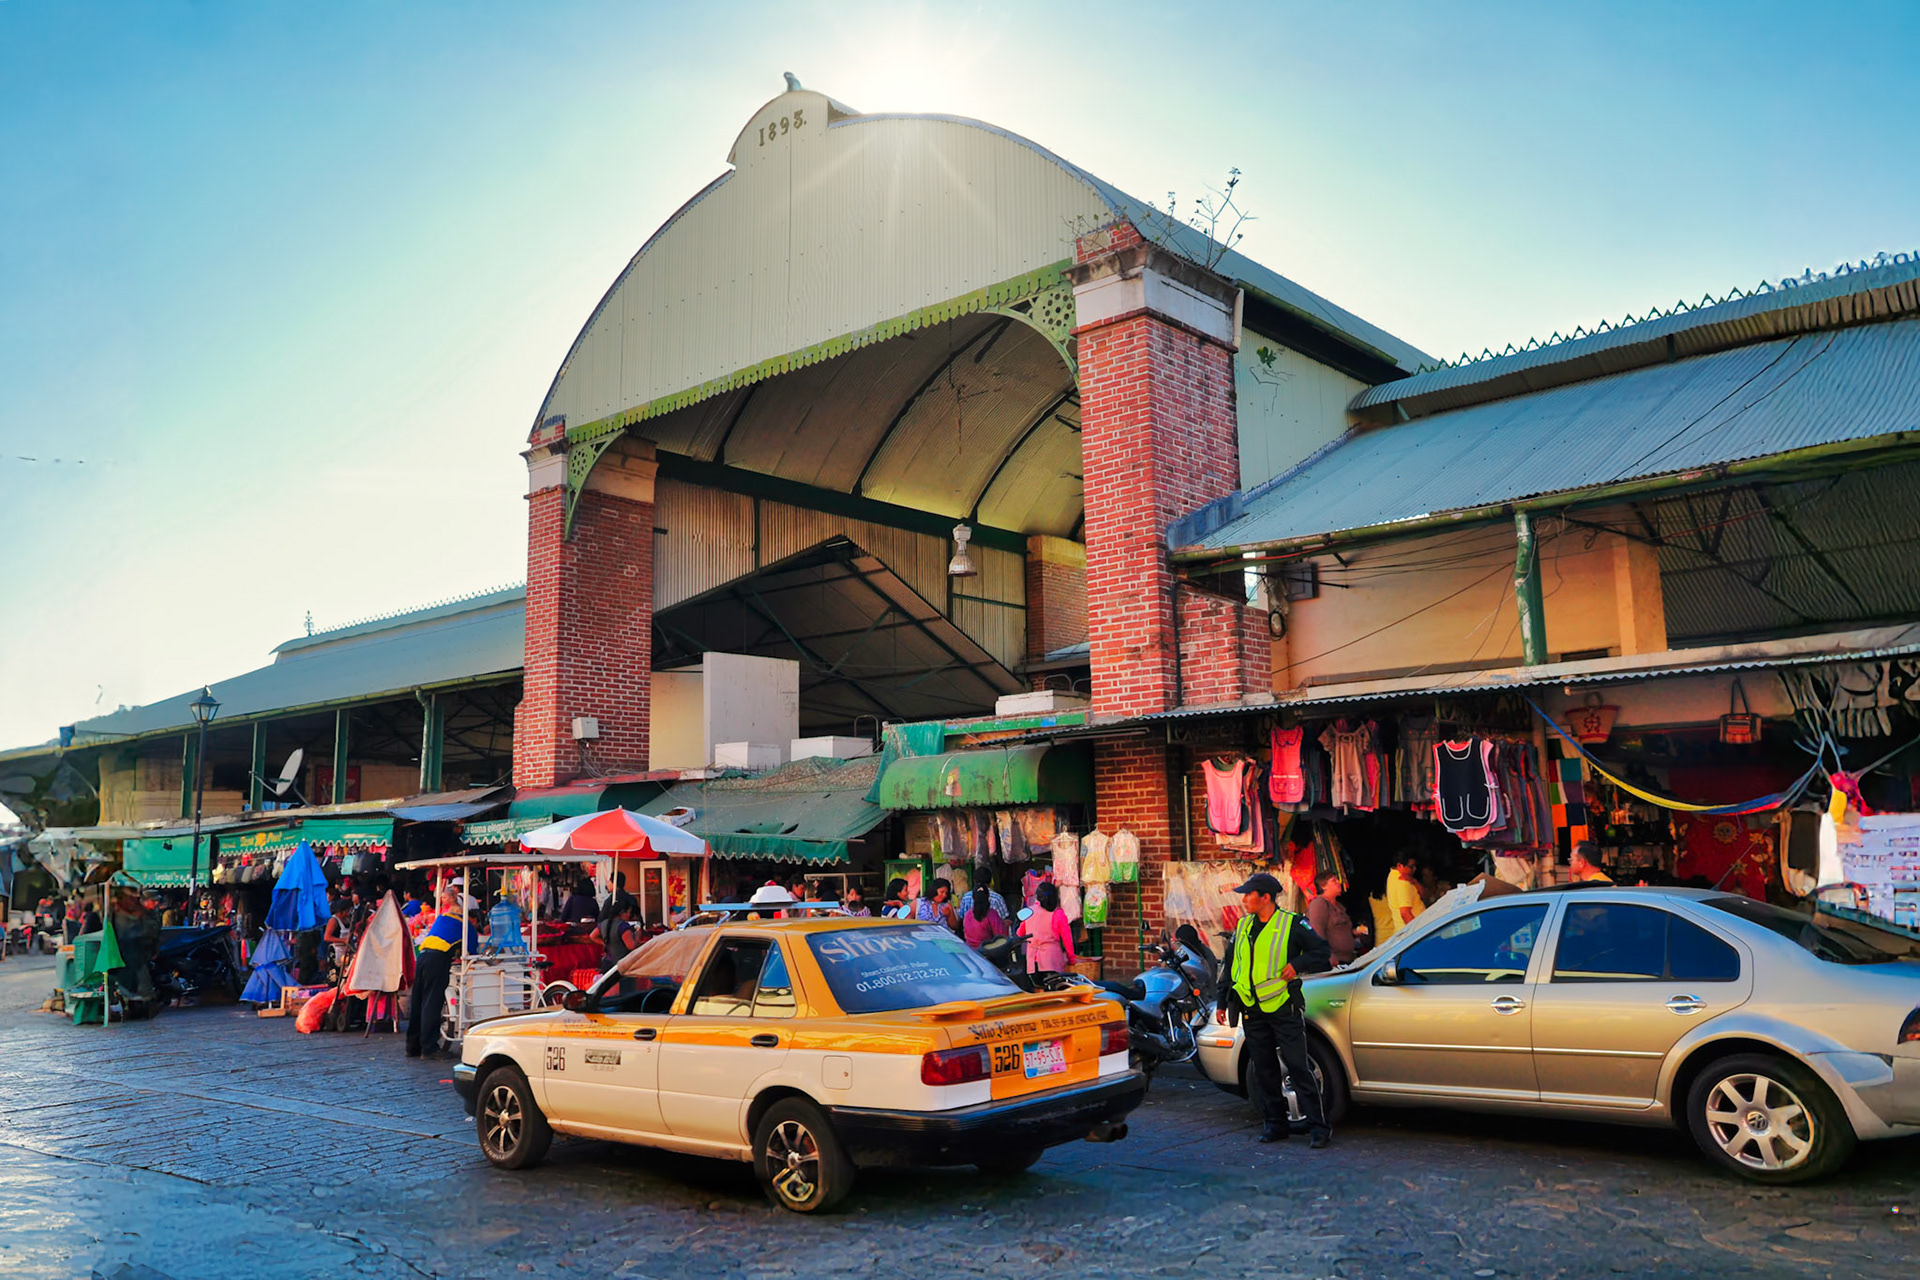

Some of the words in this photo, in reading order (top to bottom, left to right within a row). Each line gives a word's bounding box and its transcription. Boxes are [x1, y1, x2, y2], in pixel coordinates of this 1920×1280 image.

[819, 935, 918, 965] Shoes
[856, 967, 950, 993] 01.800.72.72.527
[546, 1046, 566, 1071] 526
[994, 1043, 1020, 1073] 526
